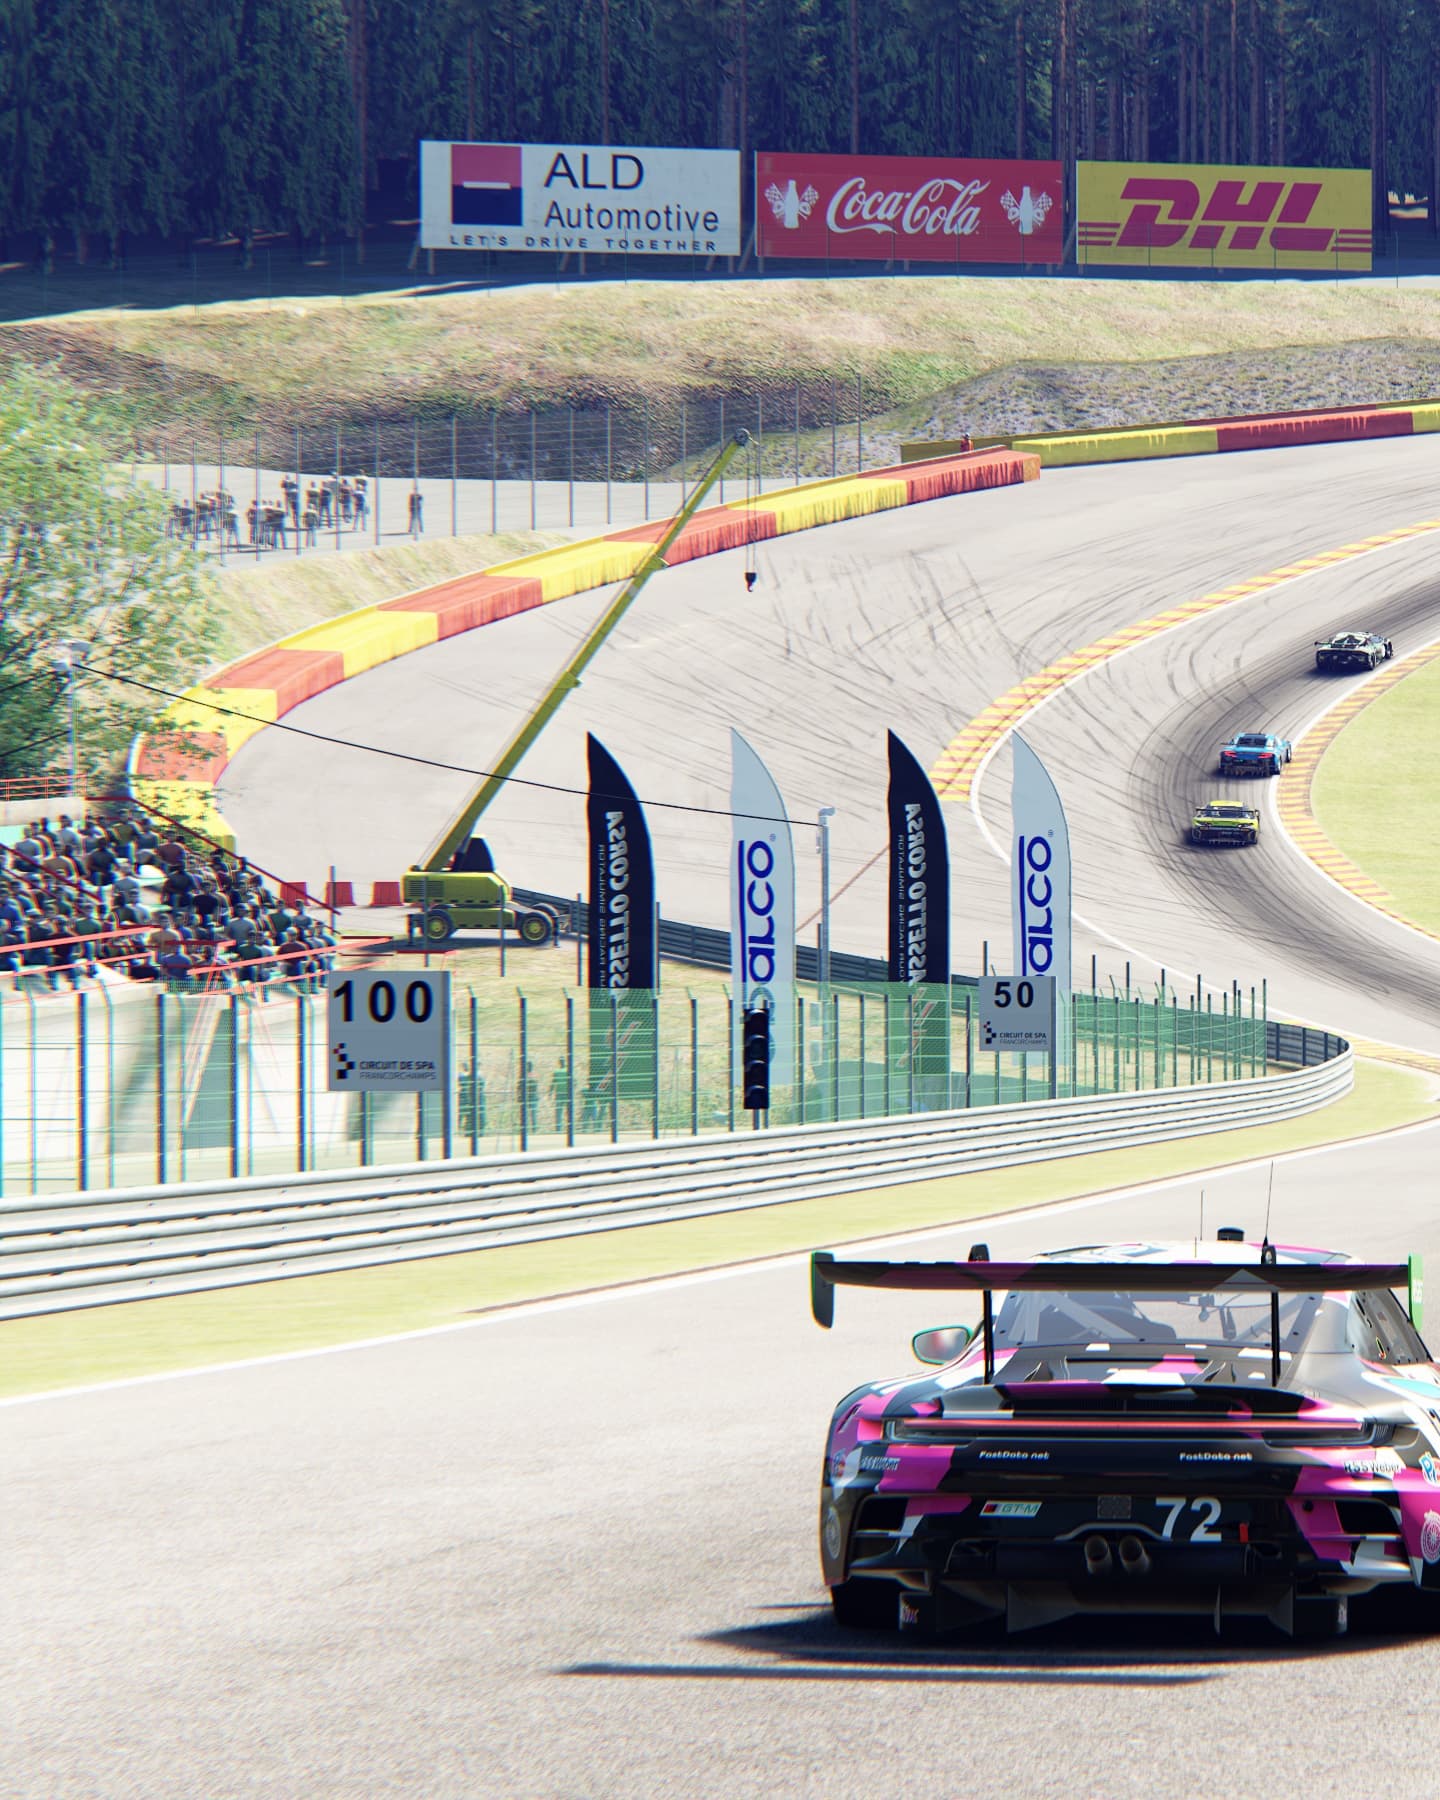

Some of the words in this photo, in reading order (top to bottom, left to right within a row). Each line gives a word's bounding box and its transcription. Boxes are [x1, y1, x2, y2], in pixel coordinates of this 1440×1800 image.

[544, 152, 645, 190] ALD
[544, 200, 720, 233] Automotive
[826, 176, 992, 235] Coca-Cola
[1116, 178, 1335, 252] DHL
[450, 234, 508, 247] LET'S
[525, 236, 588, 248] DRIVE
[605, 238, 716, 251] TOGETHER
[1025, 836, 1053, 976] arco
[333, 980, 434, 1023] 100
[994, 981, 1034, 1008] 50
[1000, 1031, 1023, 1039] CIRCUIT
[1034, 1031, 1047, 1039] SPA
[359, 1061, 398, 1070] CIRCUIT
[400, 1061, 413, 1070] DE
[415, 1061, 435, 1070] SPA
[1154, 1496, 1223, 1542] 72
